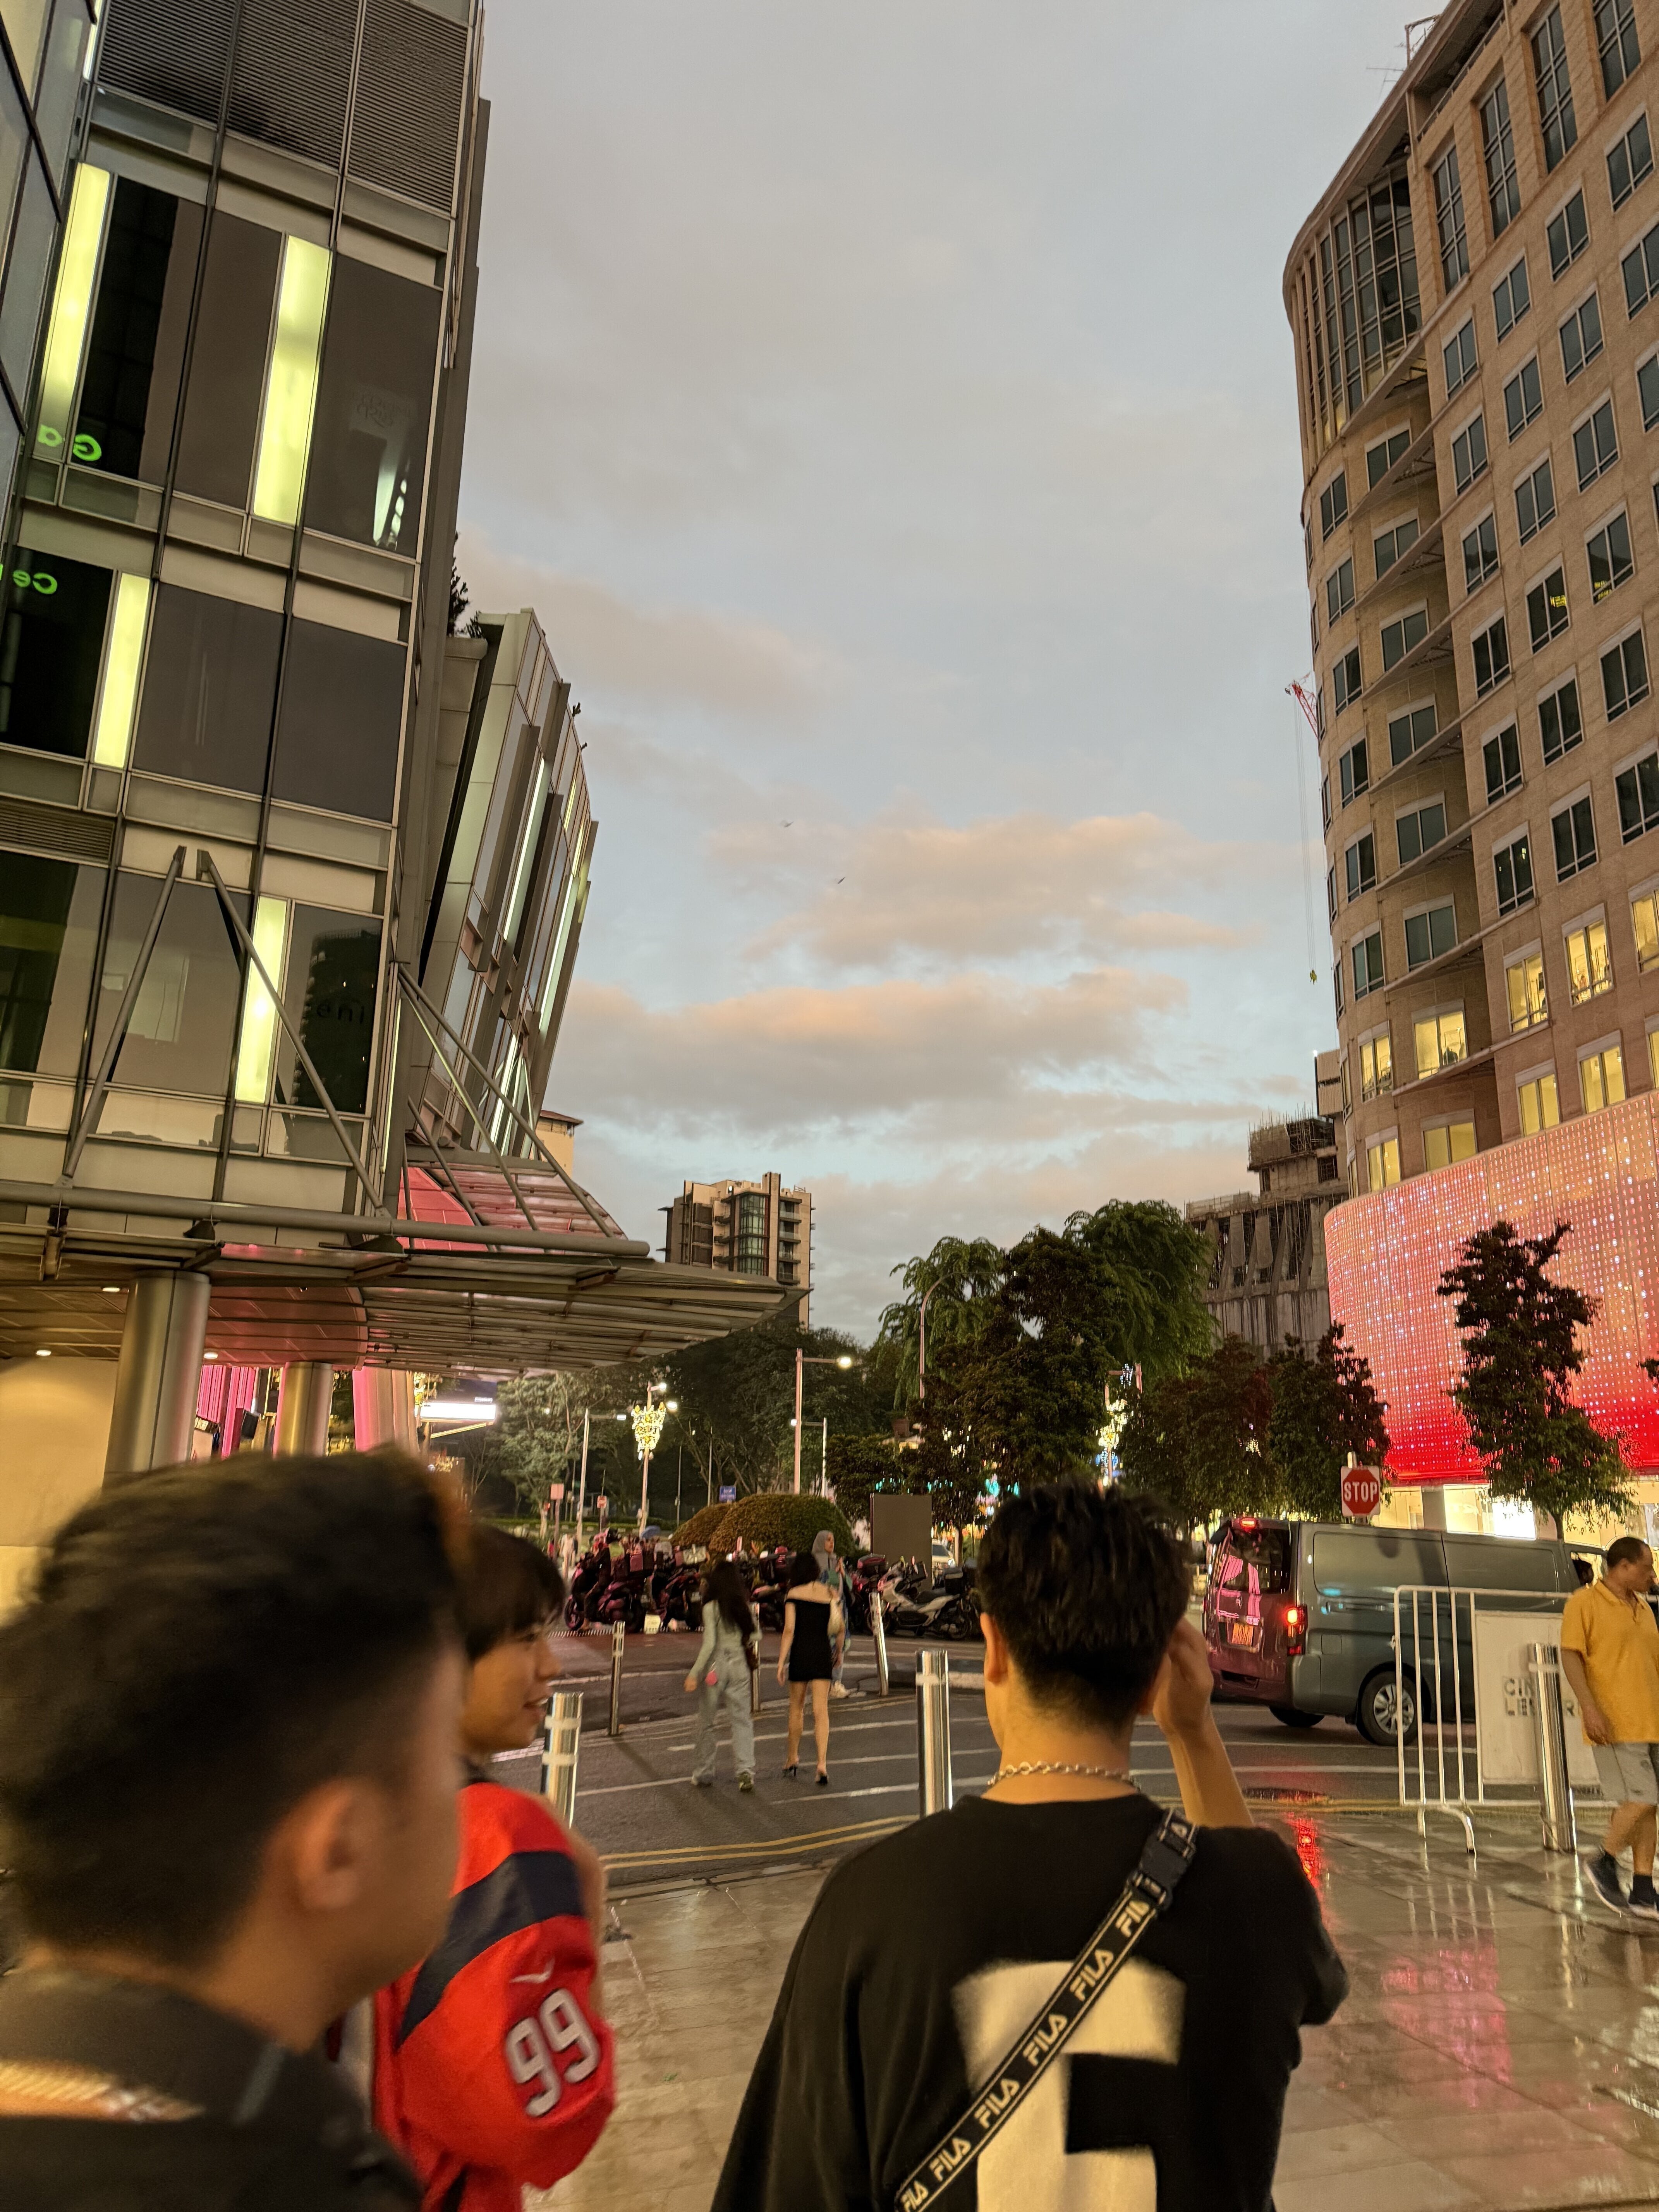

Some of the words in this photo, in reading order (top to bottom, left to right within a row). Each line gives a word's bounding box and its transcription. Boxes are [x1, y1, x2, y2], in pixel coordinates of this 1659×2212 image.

[1344, 1481, 1377, 1503] STOP
[505, 1987, 601, 2118] 99
[930, 2138, 971, 2181] FILA
[974, 2079, 1019, 2129] FILA
[1023, 2014, 1067, 2066] FILA
[1070, 1949, 1114, 2001] FILA
[1115, 1900, 1150, 1937] FIL
